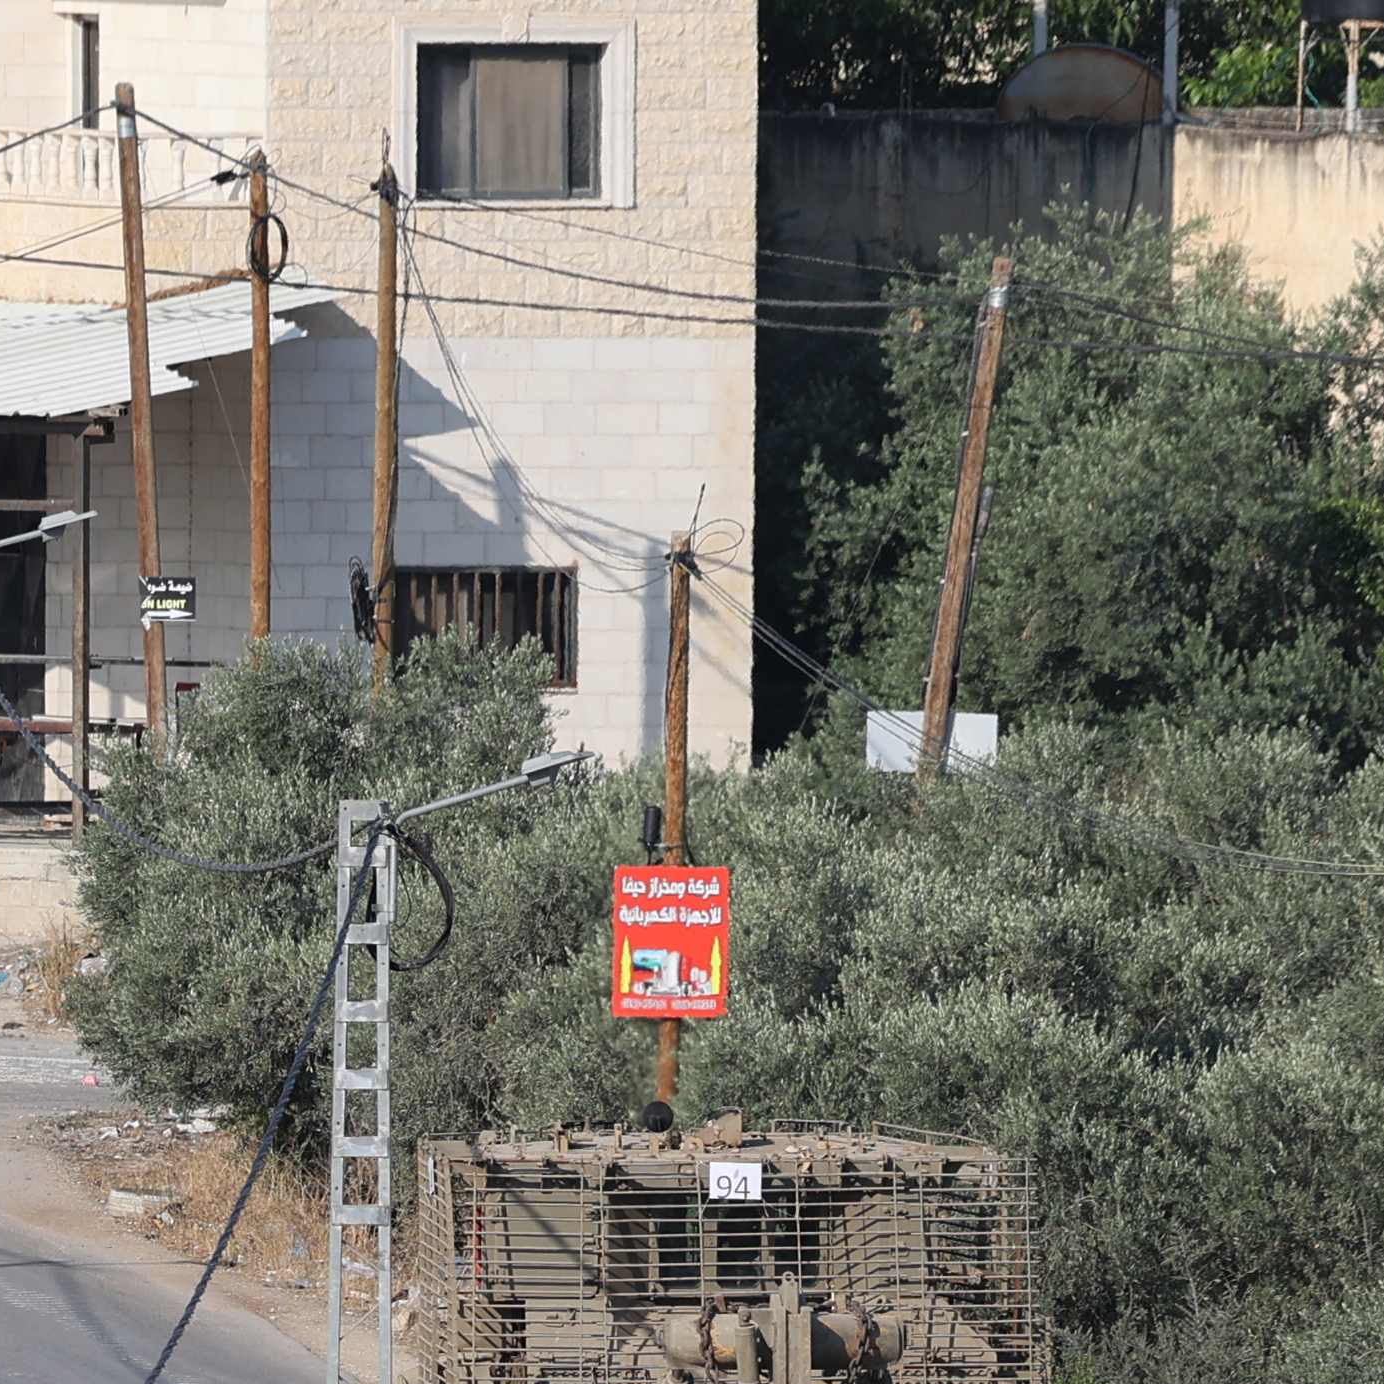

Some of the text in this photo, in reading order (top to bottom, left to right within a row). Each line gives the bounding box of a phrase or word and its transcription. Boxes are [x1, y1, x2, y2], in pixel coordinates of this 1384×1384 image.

[156, 599, 186, 609] LIGHT
[687, 876, 720, 899] شركة
[619, 903, 722, 928] للأجهزة الكهربائية
[716, 1175, 751, 1200] 94
